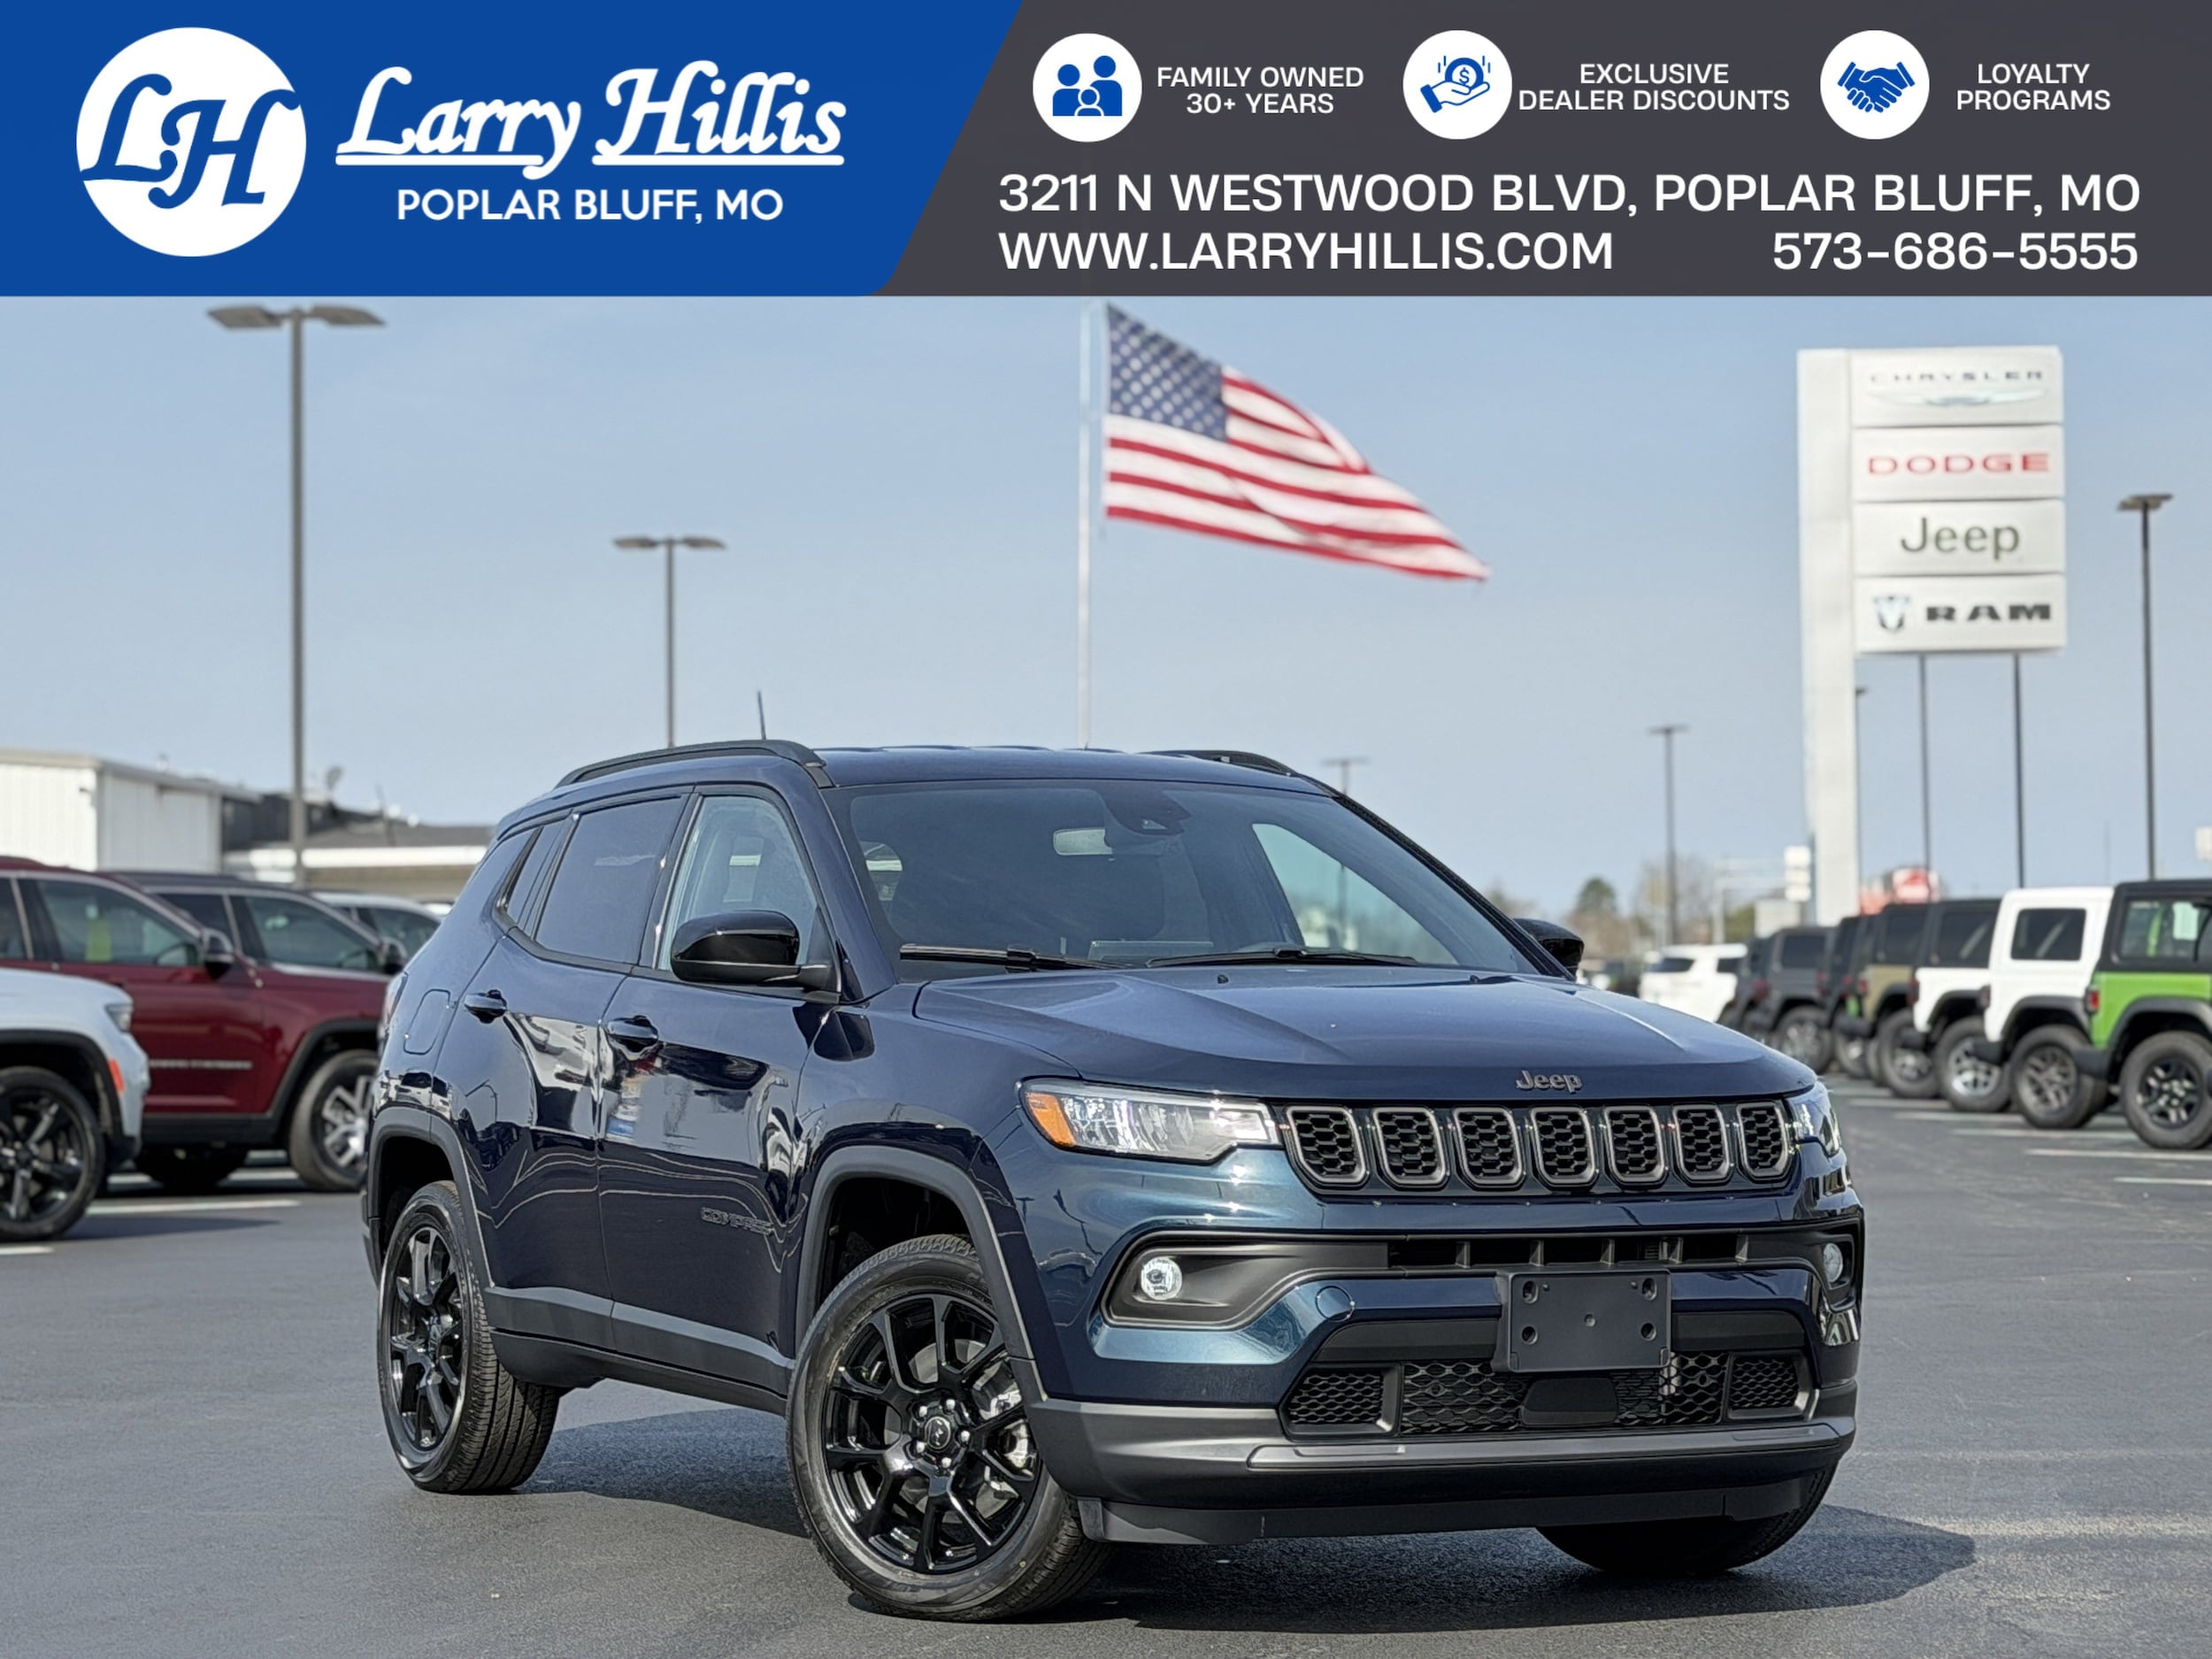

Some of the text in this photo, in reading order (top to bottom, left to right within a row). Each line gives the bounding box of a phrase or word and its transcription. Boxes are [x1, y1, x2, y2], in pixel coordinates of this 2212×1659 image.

[1868, 451, 2050, 475] DODGE
[1900, 517, 2021, 561] Jeep
[1925, 603, 2052, 621] RAM
[1515, 1069, 1583, 1094] Jeep
